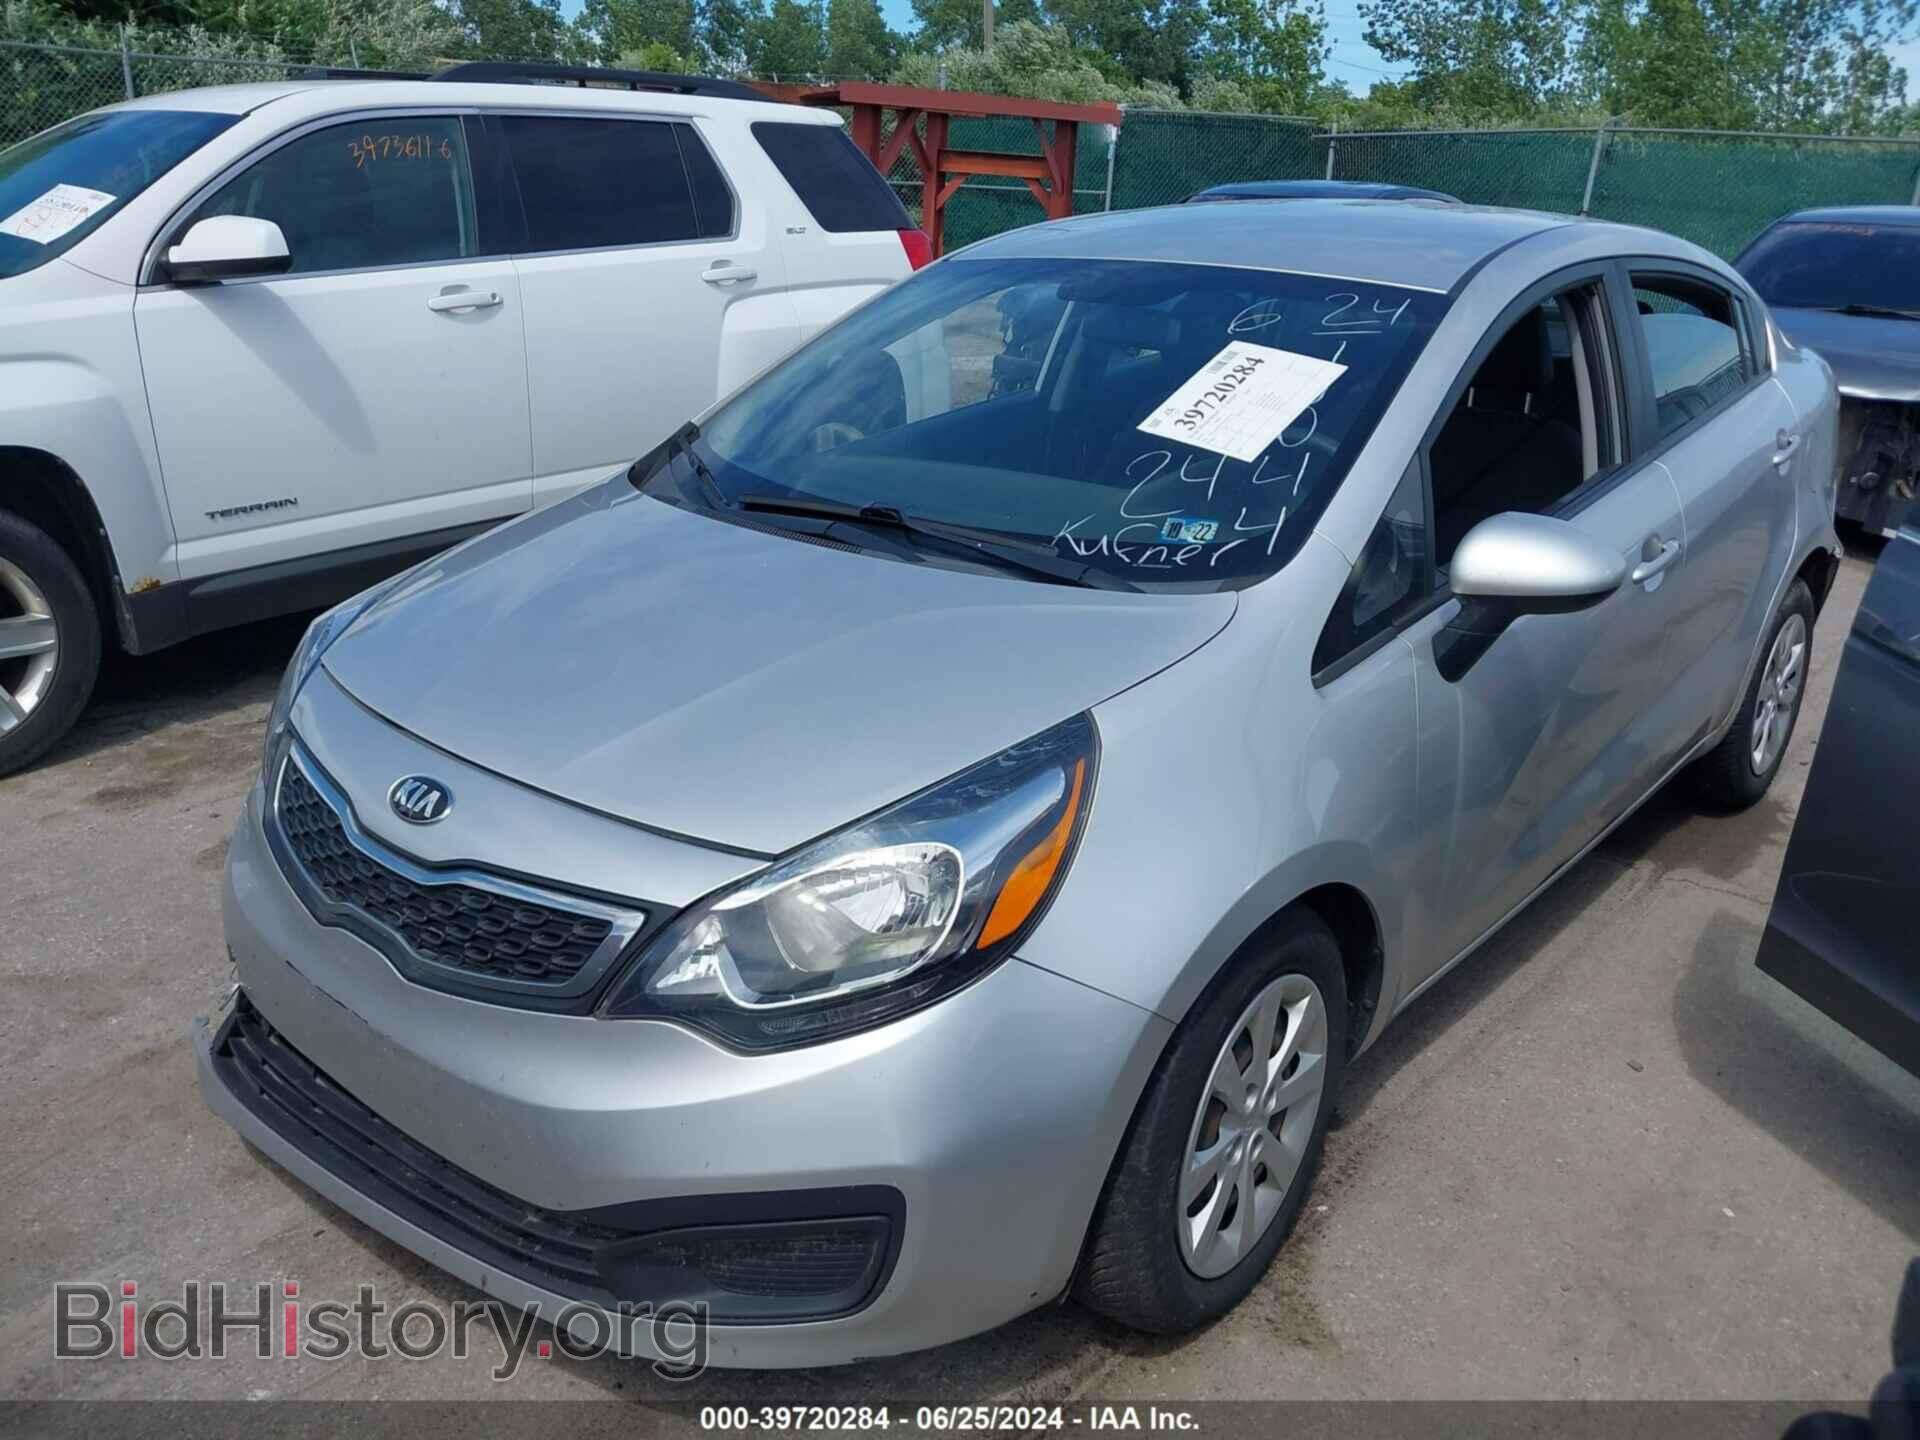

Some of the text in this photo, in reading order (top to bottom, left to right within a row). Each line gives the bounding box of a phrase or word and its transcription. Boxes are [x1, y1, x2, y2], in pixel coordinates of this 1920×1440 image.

[1315, 293, 1411, 335] 24
[1174, 355, 1265, 431] 39720284
[204, 497, 298, 519] TERRAIN
[393, 778, 441, 818] KIA
